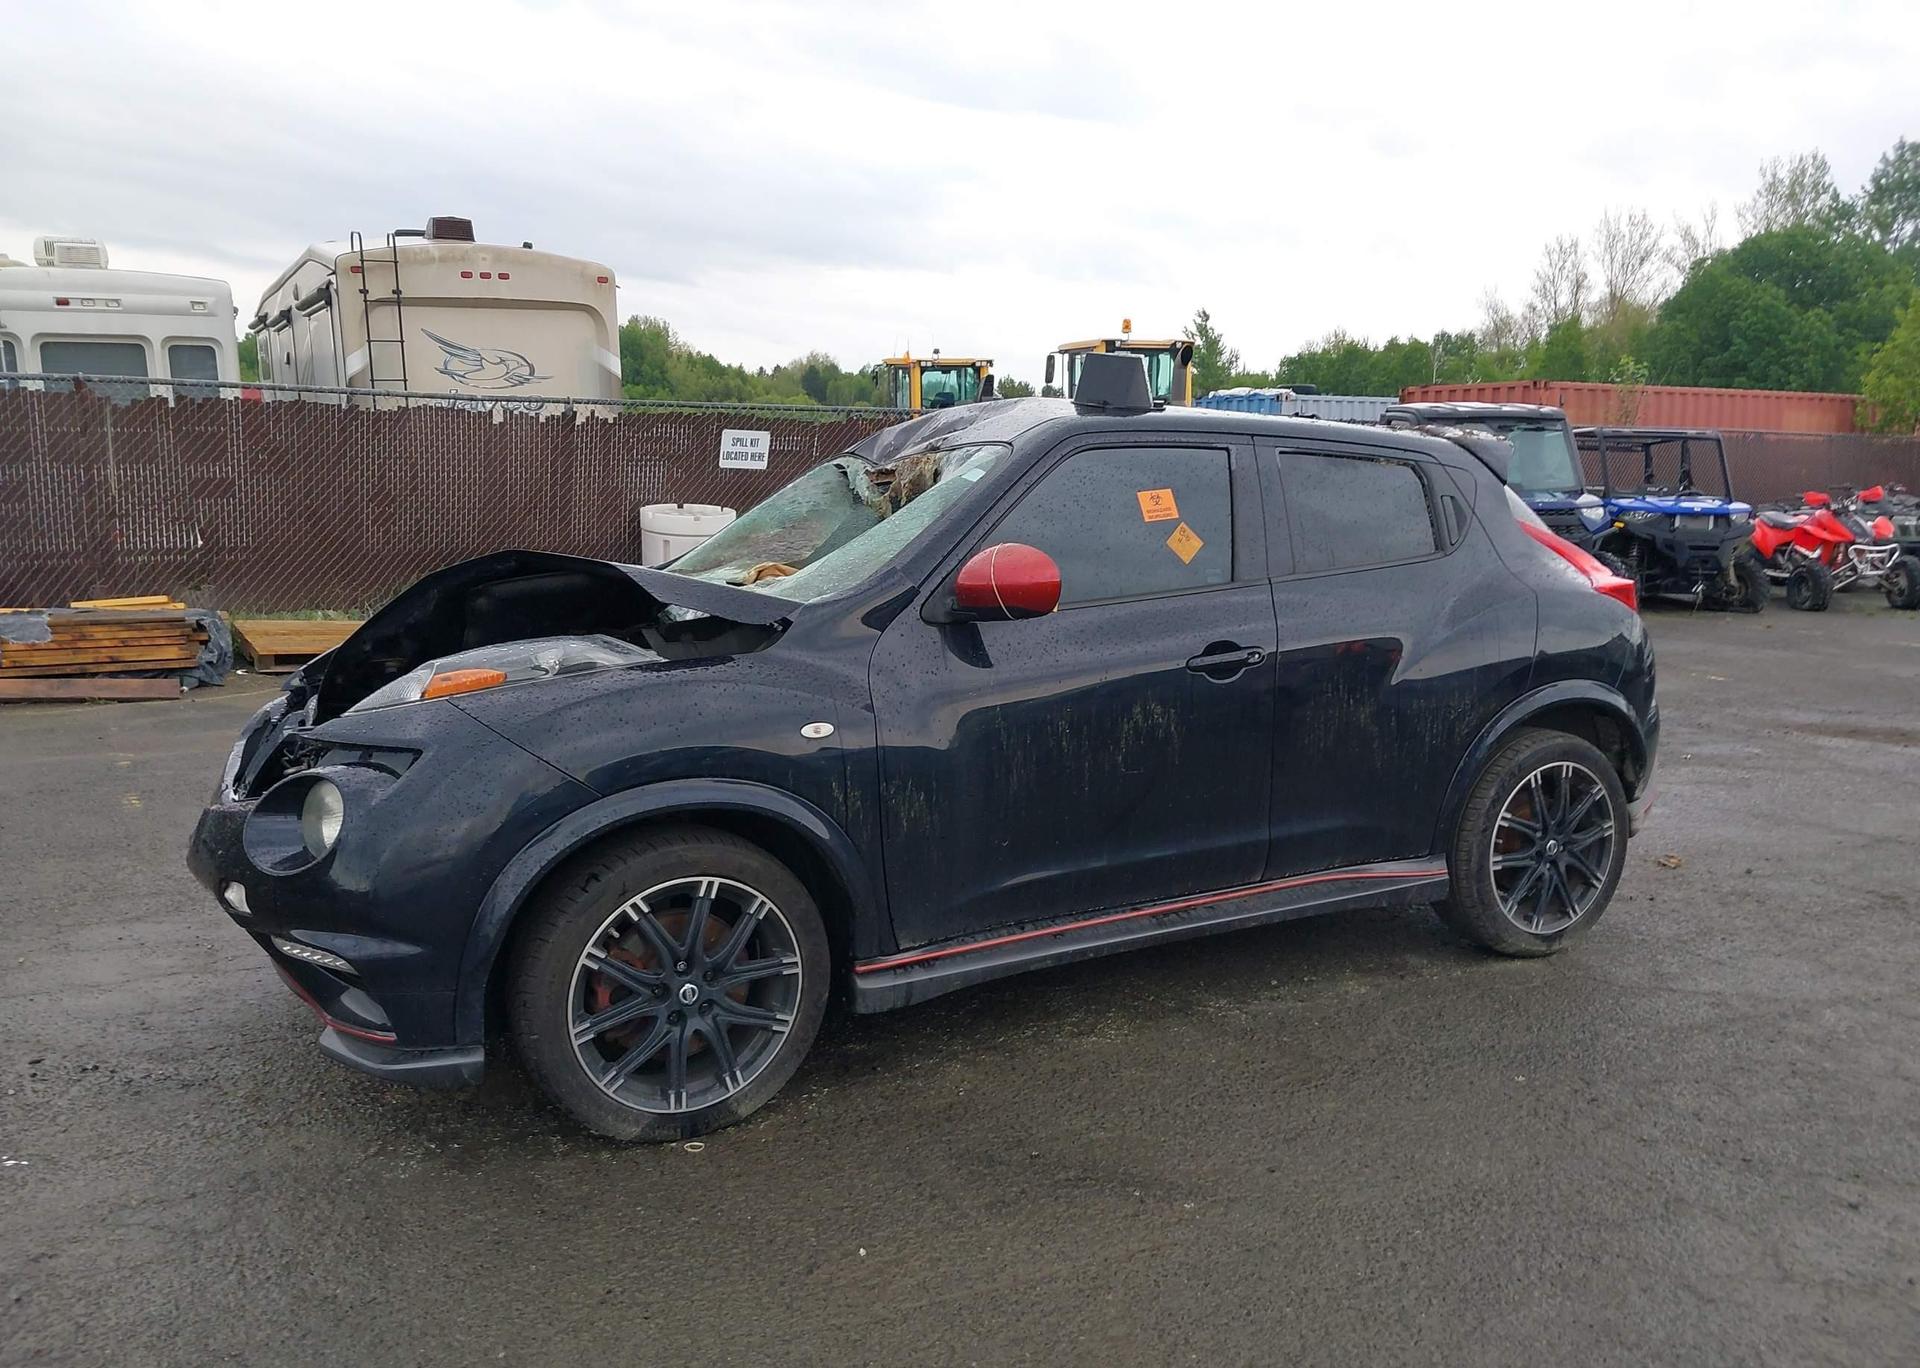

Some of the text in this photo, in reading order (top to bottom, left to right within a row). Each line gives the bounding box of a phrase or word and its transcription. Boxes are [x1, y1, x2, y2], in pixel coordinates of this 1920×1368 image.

[731, 437, 760, 448] SPILL KIT
[722, 450, 766, 462] LOCATED HERE
